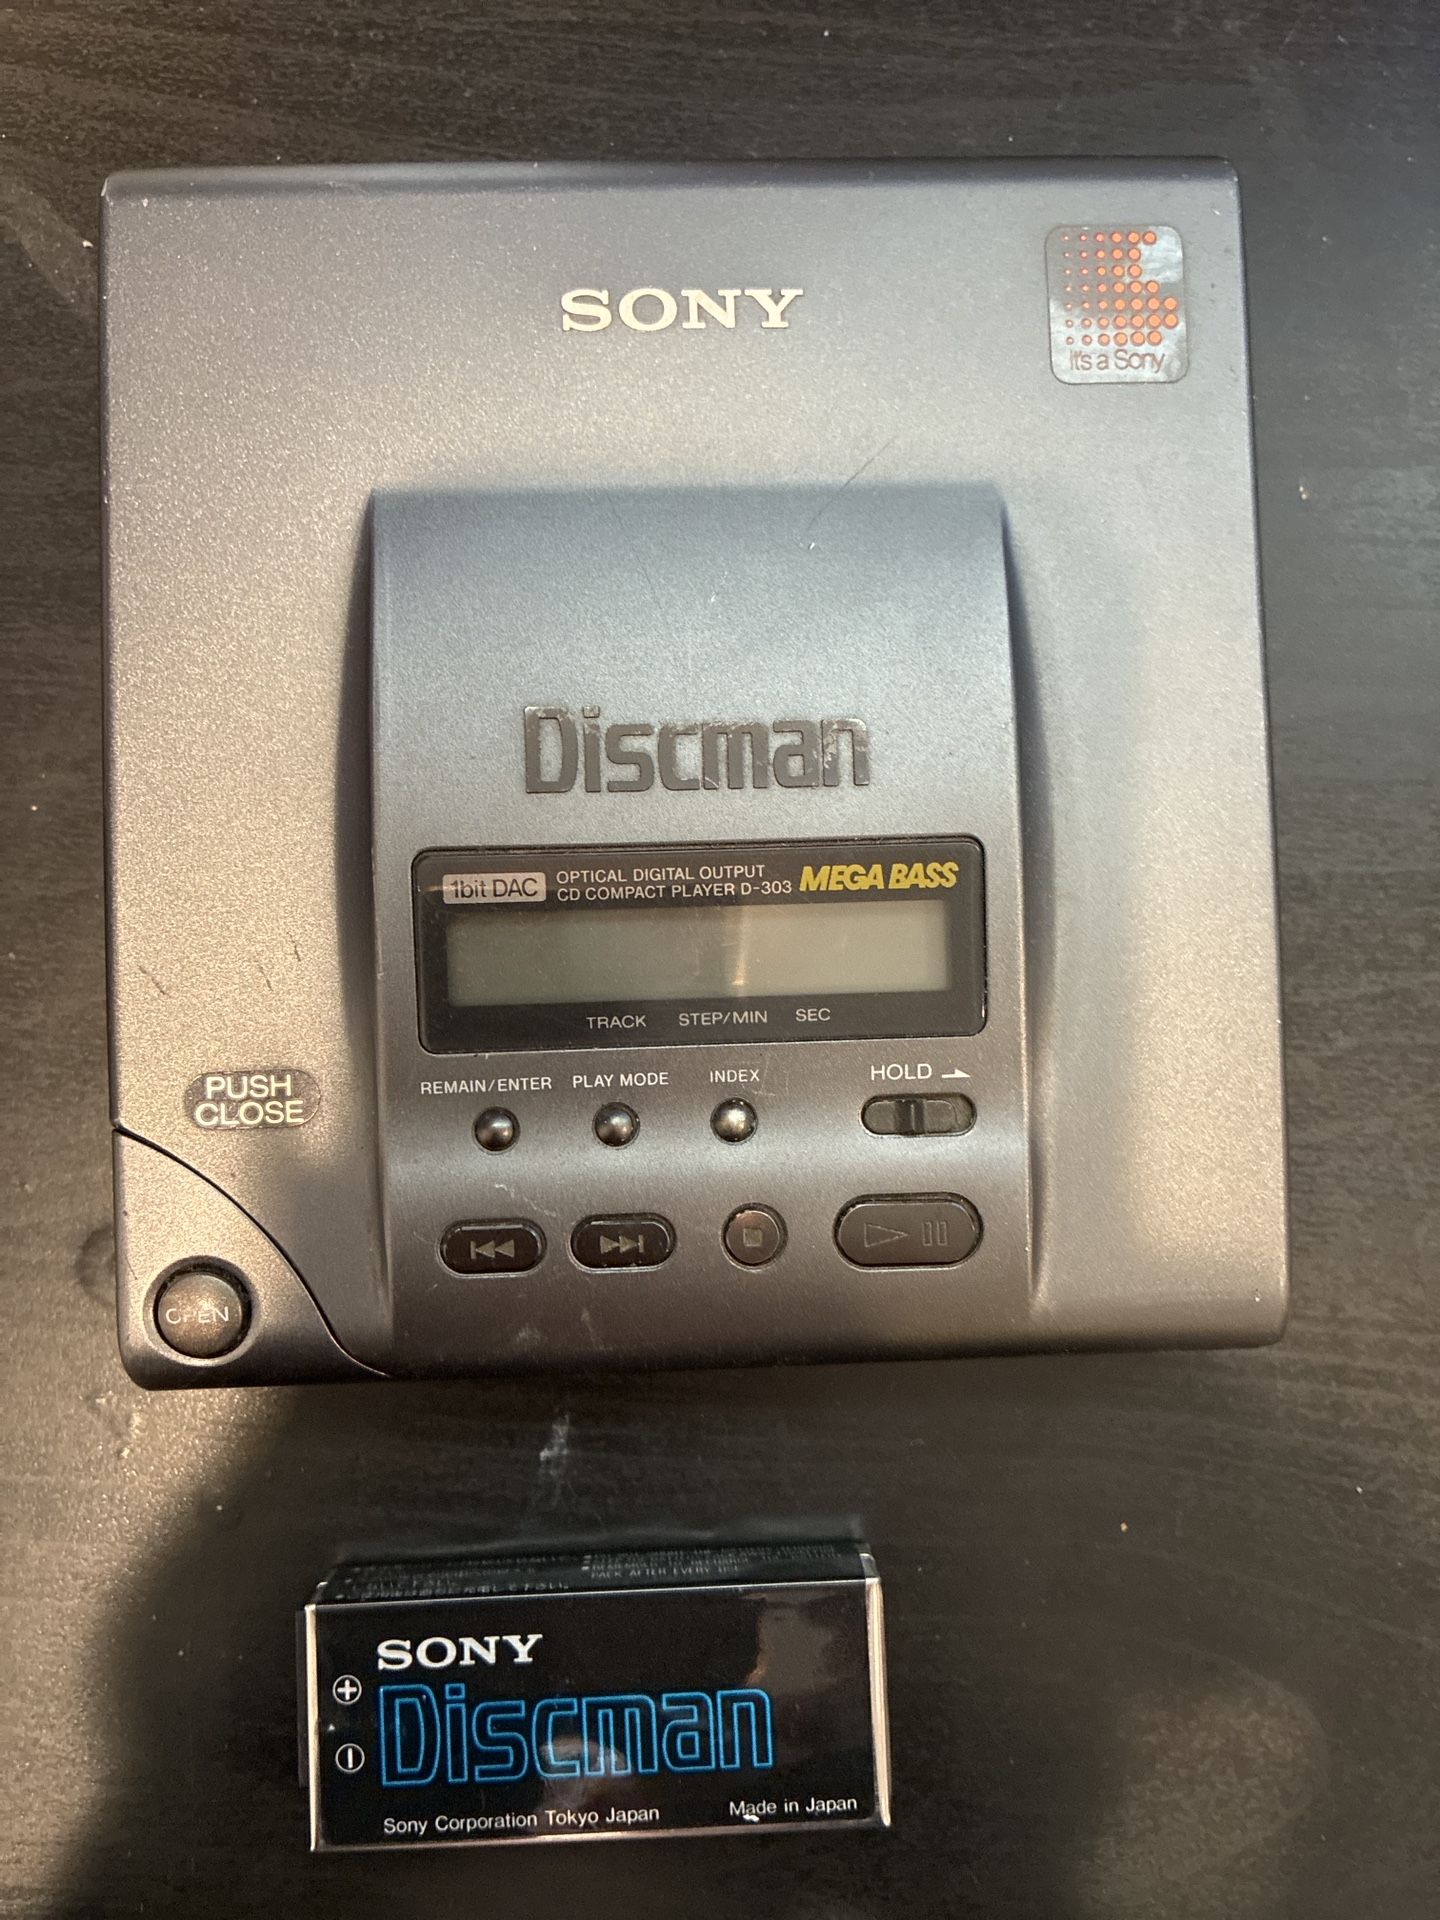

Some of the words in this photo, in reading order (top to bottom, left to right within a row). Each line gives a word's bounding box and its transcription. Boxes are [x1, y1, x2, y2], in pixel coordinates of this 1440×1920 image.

[560, 287, 804, 332] SONY
[1070, 349, 1093, 371] It's
[1097, 353, 1110, 370] a
[1114, 348, 1166, 374] Sony
[524, 705, 870, 793] Discman
[556, 868, 627, 884] OPTICAL
[633, 866, 694, 881] DIGITAL
[699, 864, 765, 879] OUTPUT
[799, 864, 885, 892] MEGA
[888, 861, 959, 889] BASS
[451, 879, 488, 898] 1bit
[493, 877, 539, 898] DAC
[557, 887, 581, 901] CD
[585, 885, 666, 900] COMPACT
[671, 882, 735, 898] PLAYER
[740, 880, 792, 896] D-303
[586, 1014, 647, 1030] TRACK
[678, 1010, 768, 1026] STEP/MIN
[795, 1007, 831, 1022] SEC
[572, 1074, 614, 1089] PLAY
[619, 1072, 669, 1087] MODE
[709, 1069, 760, 1083] INDEX
[870, 1063, 933, 1081] HOLD
[205, 1074, 293, 1100] PUSH
[420, 1077, 552, 1095] REMAIN/ENTER
[194, 1099, 305, 1128] CLOSE
[377, 1633, 543, 1671] SONY
[379, 1682, 774, 1787] Discman
[729, 1800, 777, 1817] Made
[784, 1798, 799, 1813] in
[805, 1796, 858, 1813] Japan
[383, 1817, 428, 1837] Sony
[435, 1812, 538, 1833] Corporation
[545, 1808, 599, 1827] Tokyo
[605, 1806, 660, 1825] Japan
